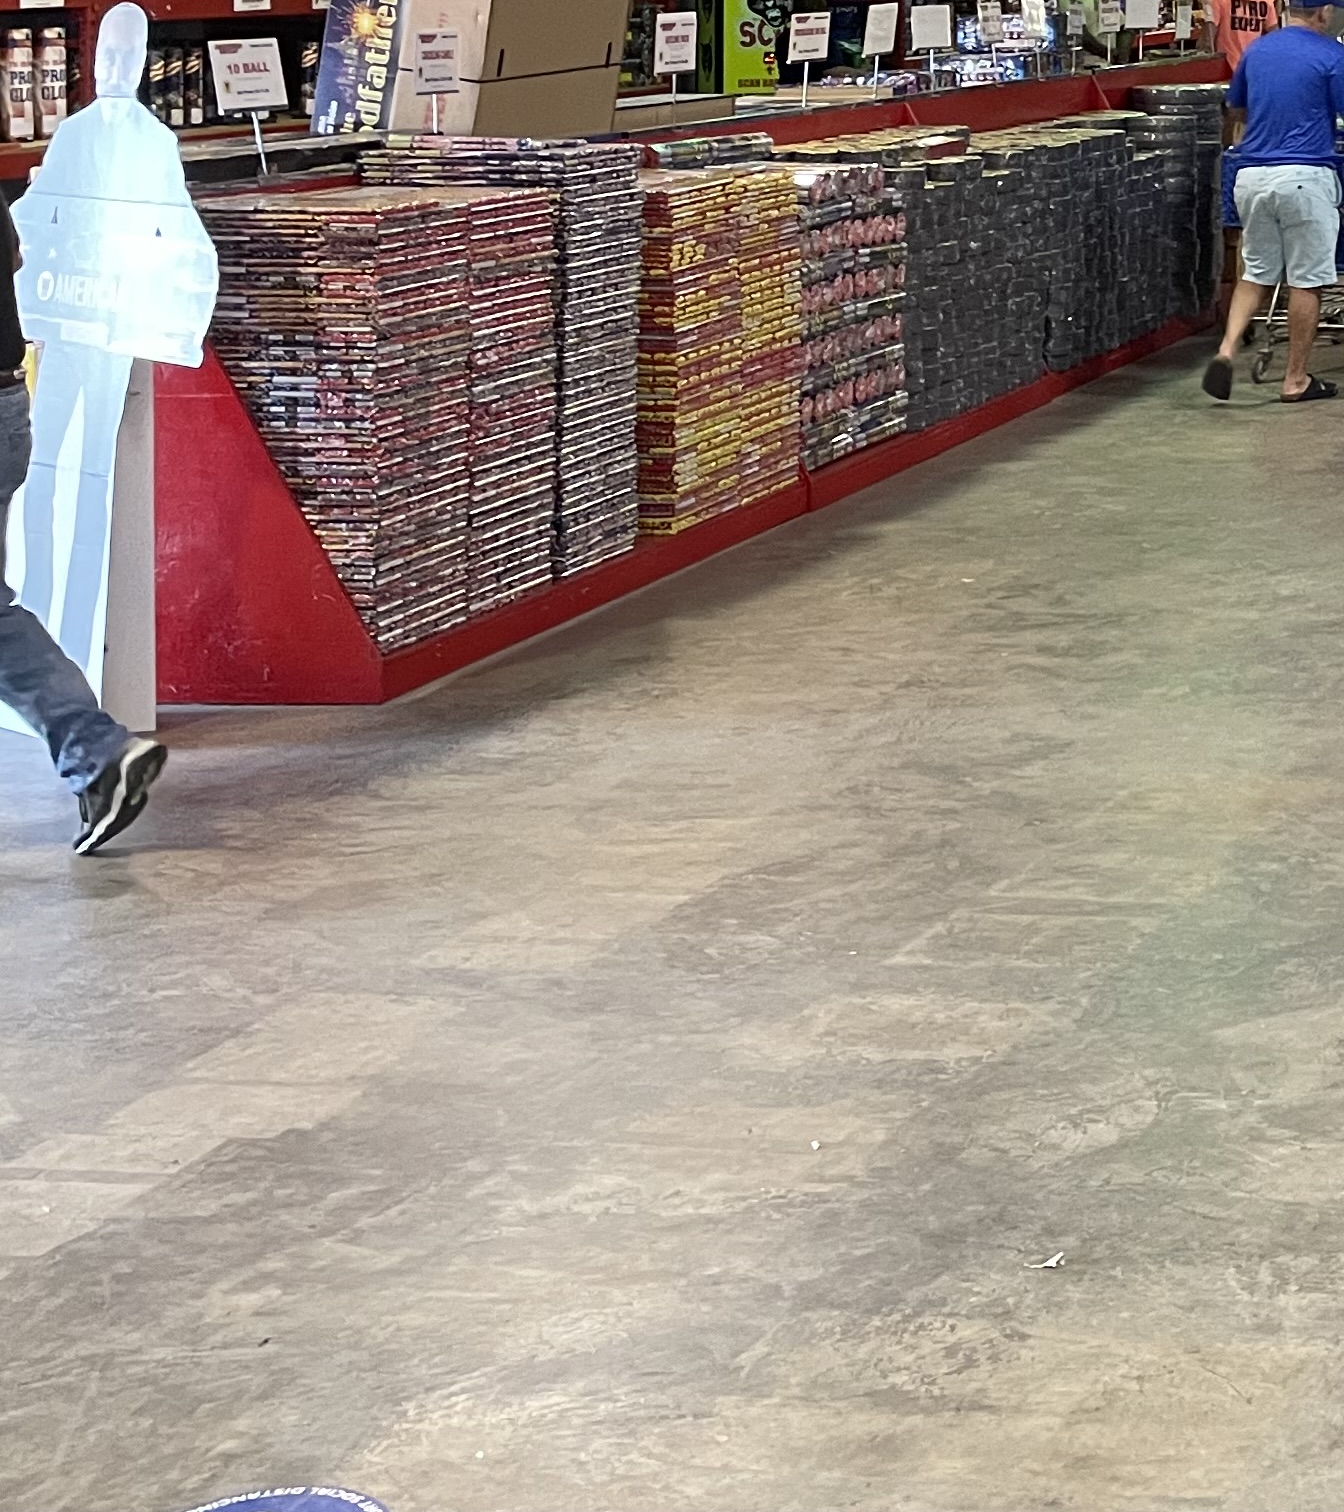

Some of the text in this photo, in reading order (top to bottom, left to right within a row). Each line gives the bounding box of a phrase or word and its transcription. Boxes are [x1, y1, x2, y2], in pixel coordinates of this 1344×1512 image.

[1231, 0, 1268, 17] PYRO
[227, 61, 271, 75] 10 BALL
[311, 1487, 366, 1504] SOCIAL
